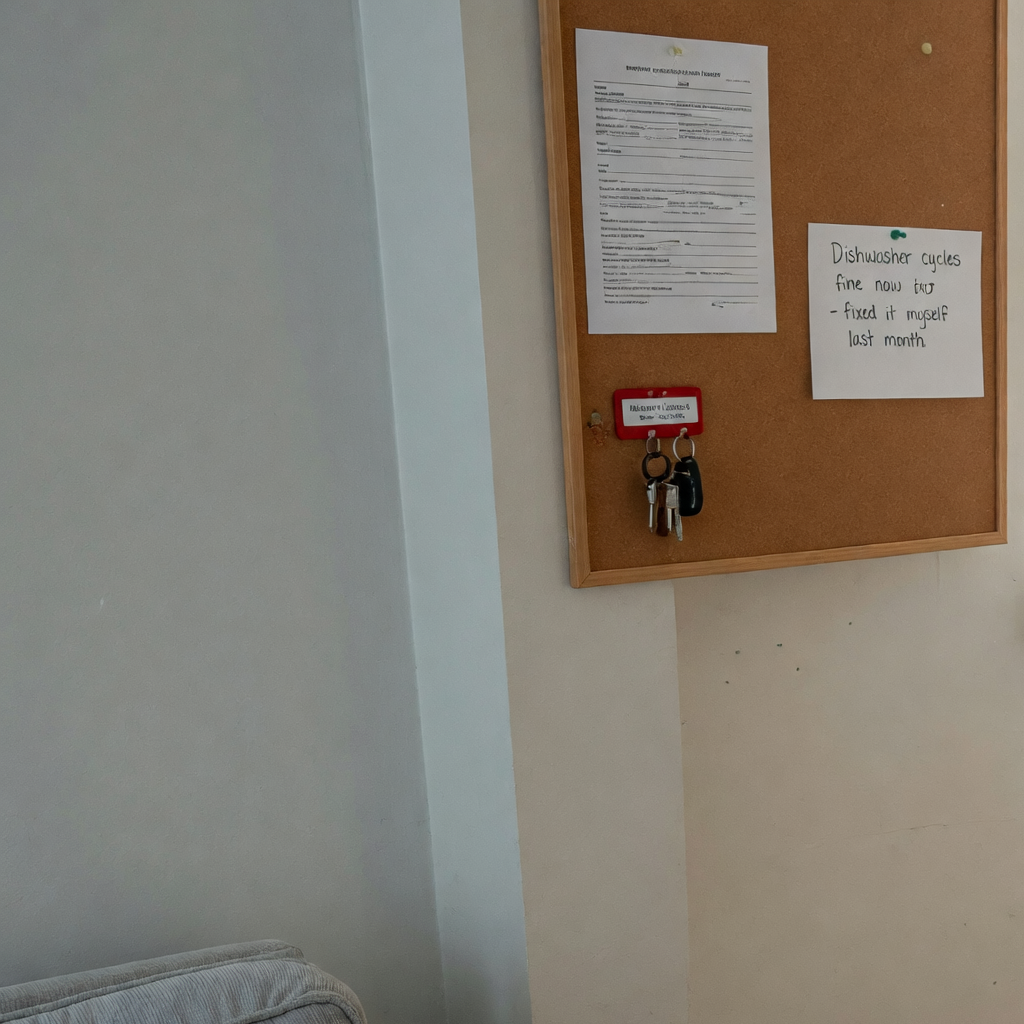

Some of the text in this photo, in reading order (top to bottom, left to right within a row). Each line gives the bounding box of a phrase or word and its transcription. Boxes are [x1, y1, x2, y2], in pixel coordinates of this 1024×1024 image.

[831, 242, 961, 273] Dishwasher cycles
[836, 273, 863, 292] fine
[875, 279, 902, 292] now
[844, 302, 877, 320] fixed
[886, 305, 896, 321] it
[907, 305, 948, 329] myself
[848, 330, 926, 348] last month
